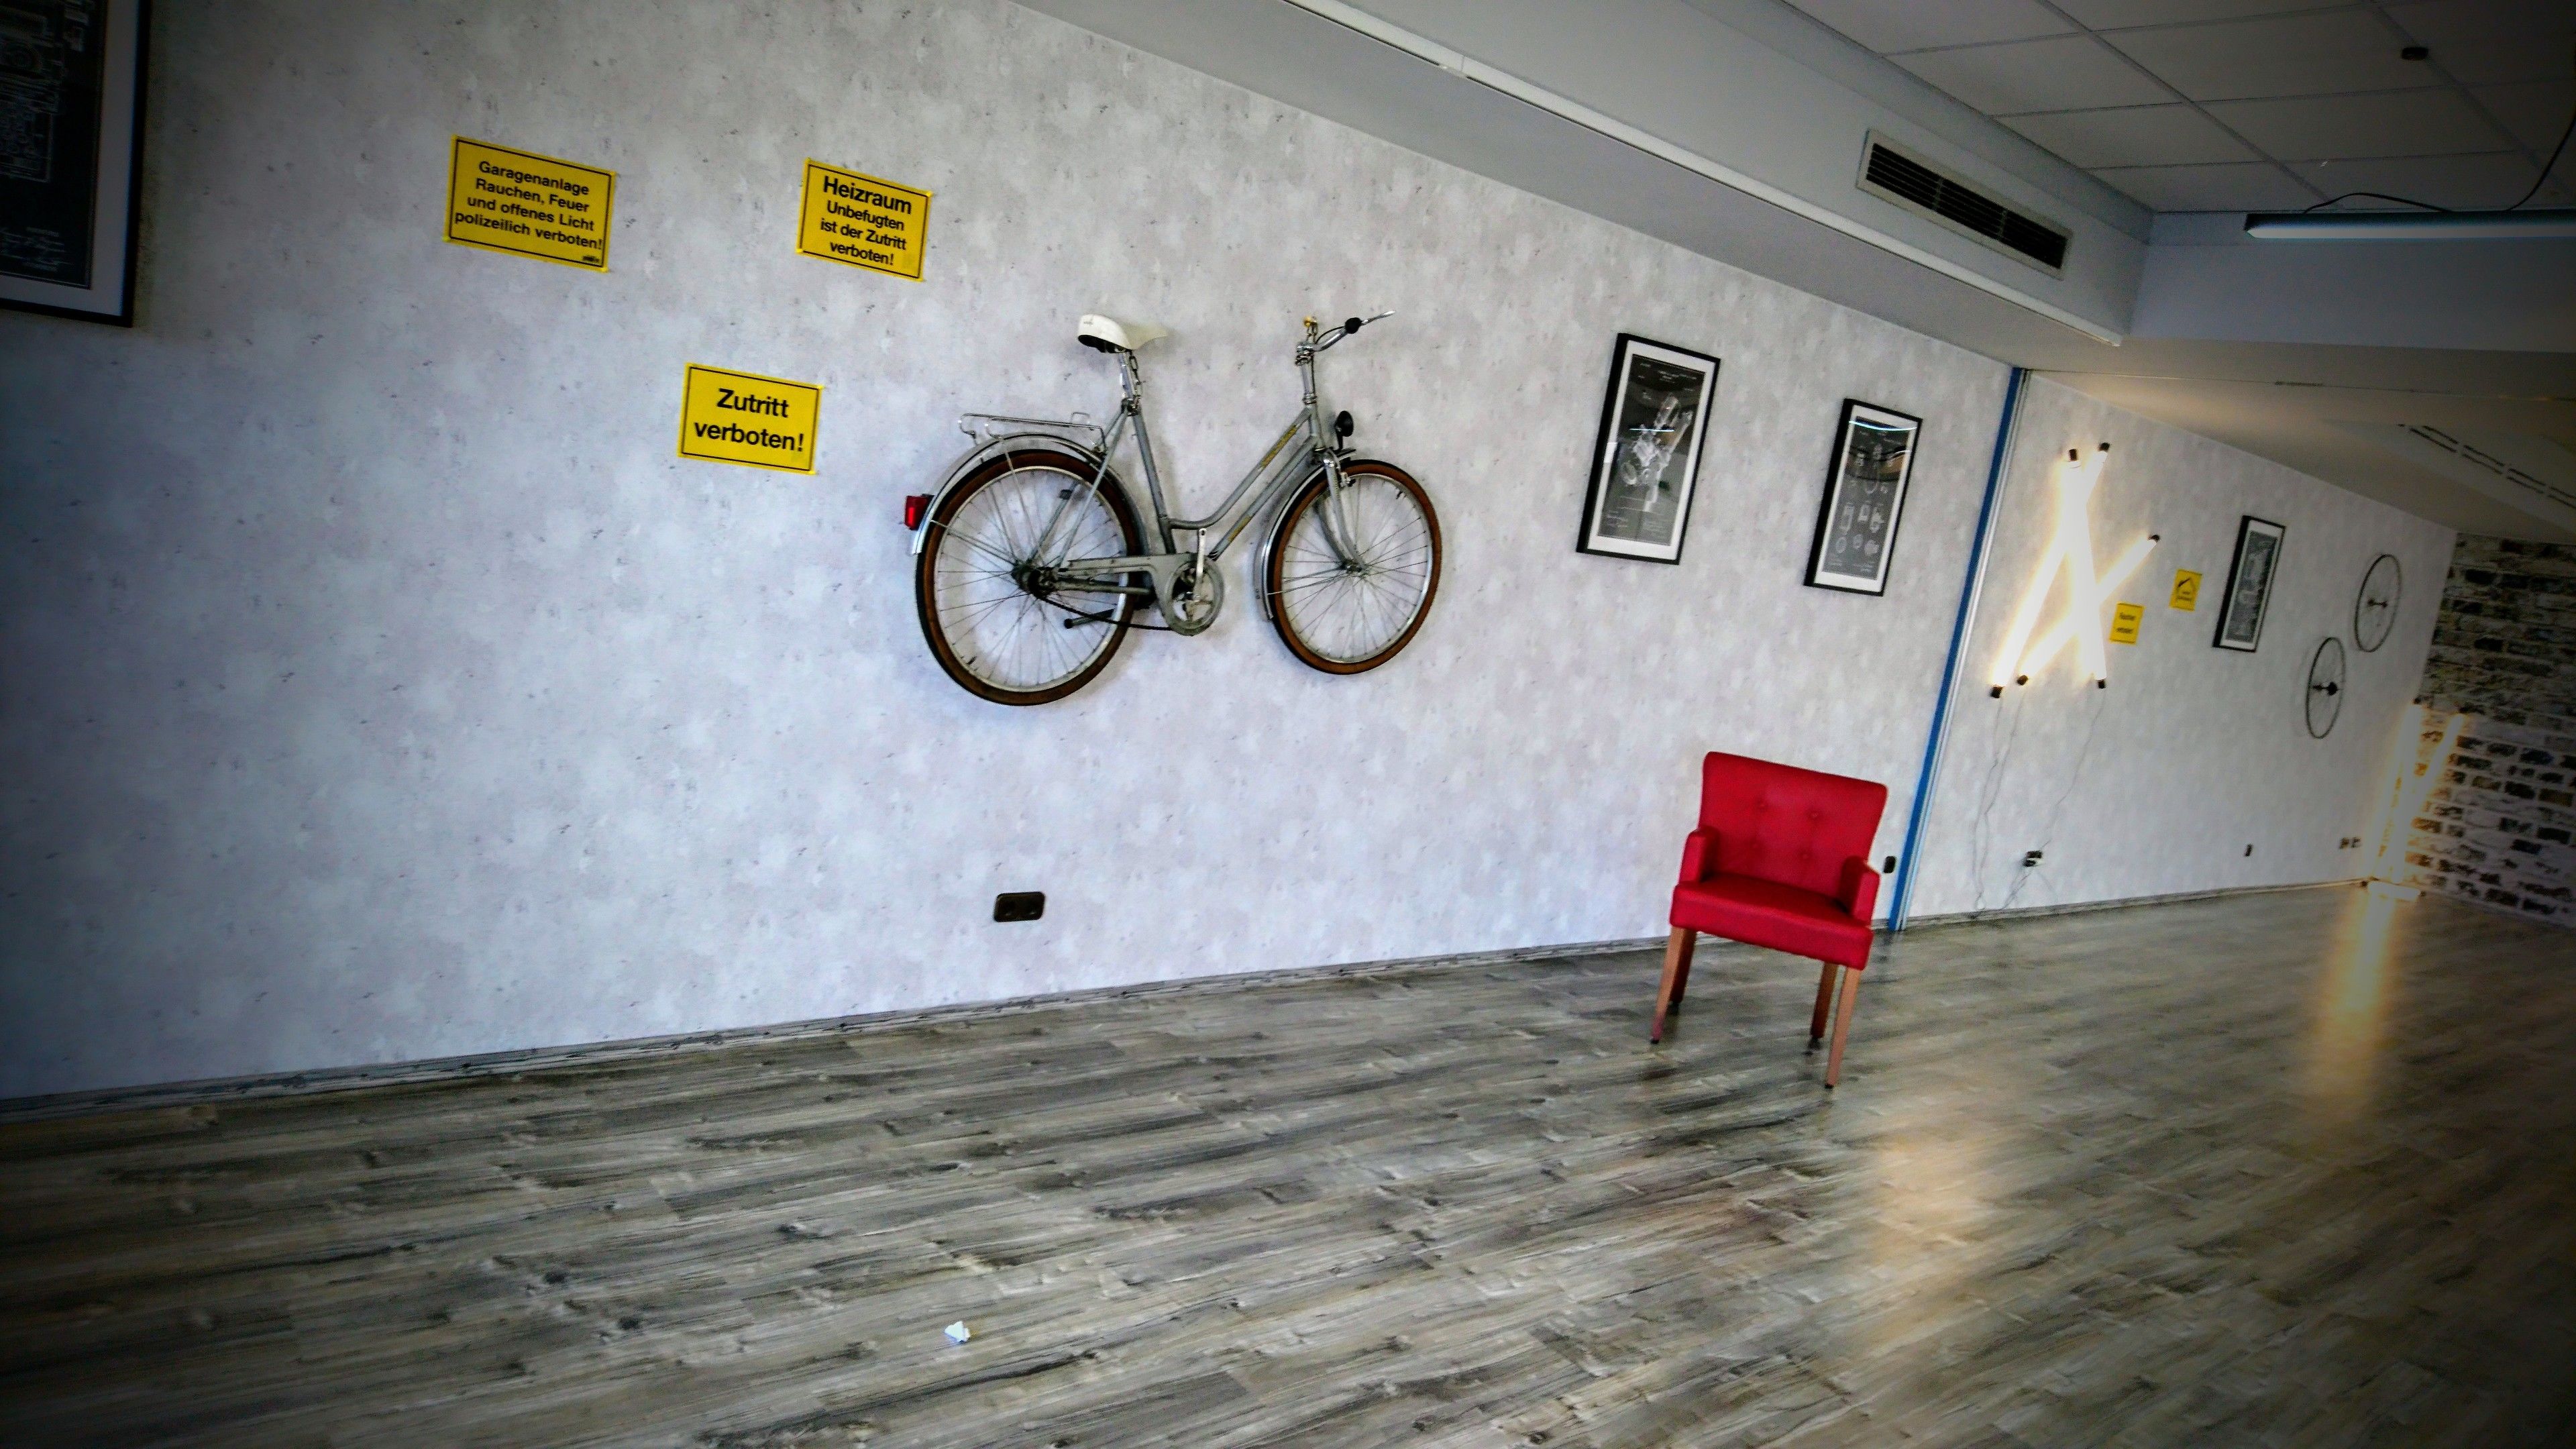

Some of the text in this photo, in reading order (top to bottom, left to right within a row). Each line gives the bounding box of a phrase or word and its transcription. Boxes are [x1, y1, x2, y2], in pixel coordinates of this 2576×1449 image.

[479, 161, 589, 195] Garagenanlage
[823, 175, 912, 214] Heizraum
[476, 178, 589, 213] Rauchen, Feuer
[467, 196, 594, 231] und offenes Licht
[826, 200, 904, 231] Unbefugten
[455, 212, 602, 250] polizeilich verboten!
[820, 217, 906, 250] ist der Zutritt
[830, 241, 894, 266] verboten!
[716, 388, 789, 418] Zutritt
[694, 422, 804, 452] verboten!
